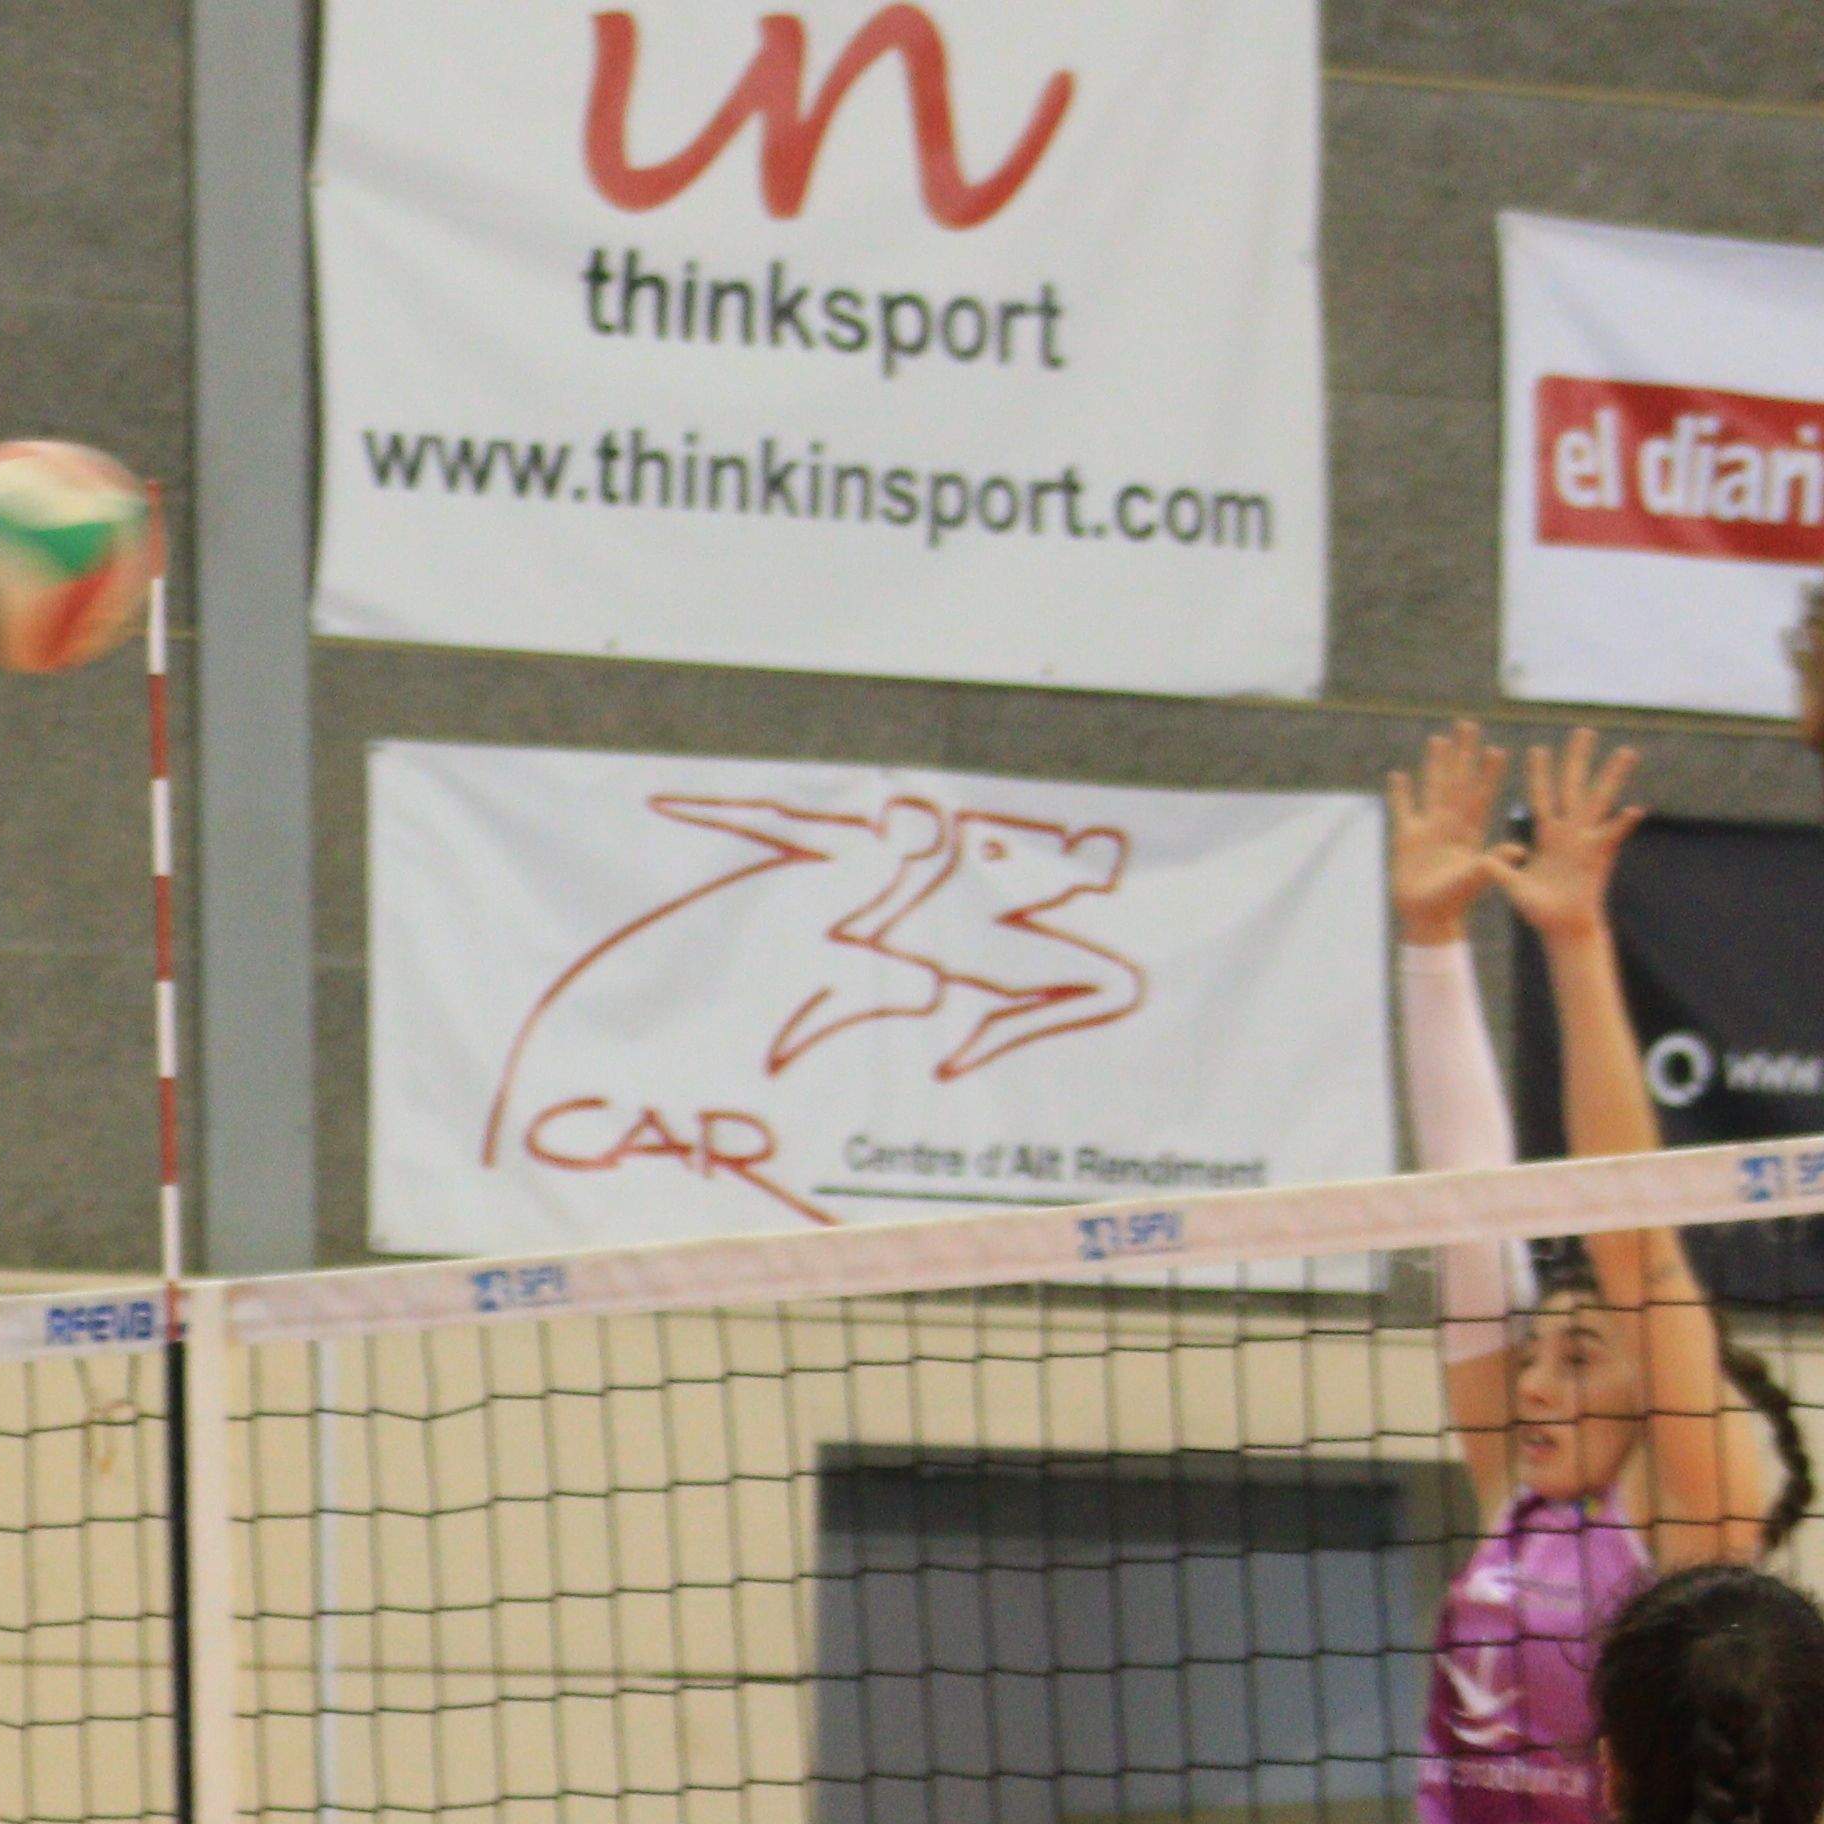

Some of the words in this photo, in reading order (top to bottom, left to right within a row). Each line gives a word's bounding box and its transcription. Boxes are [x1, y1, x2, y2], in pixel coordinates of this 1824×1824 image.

[583, 247, 1065, 378] thinksport
[362, 425, 1274, 550] www.thinkinsport.com
[1556, 404, 1622, 511] el
[522, 1096, 842, 1226] CAR
[846, 1134, 965, 1177] Centre
[1073, 1143, 1267, 1188] Rendiment
